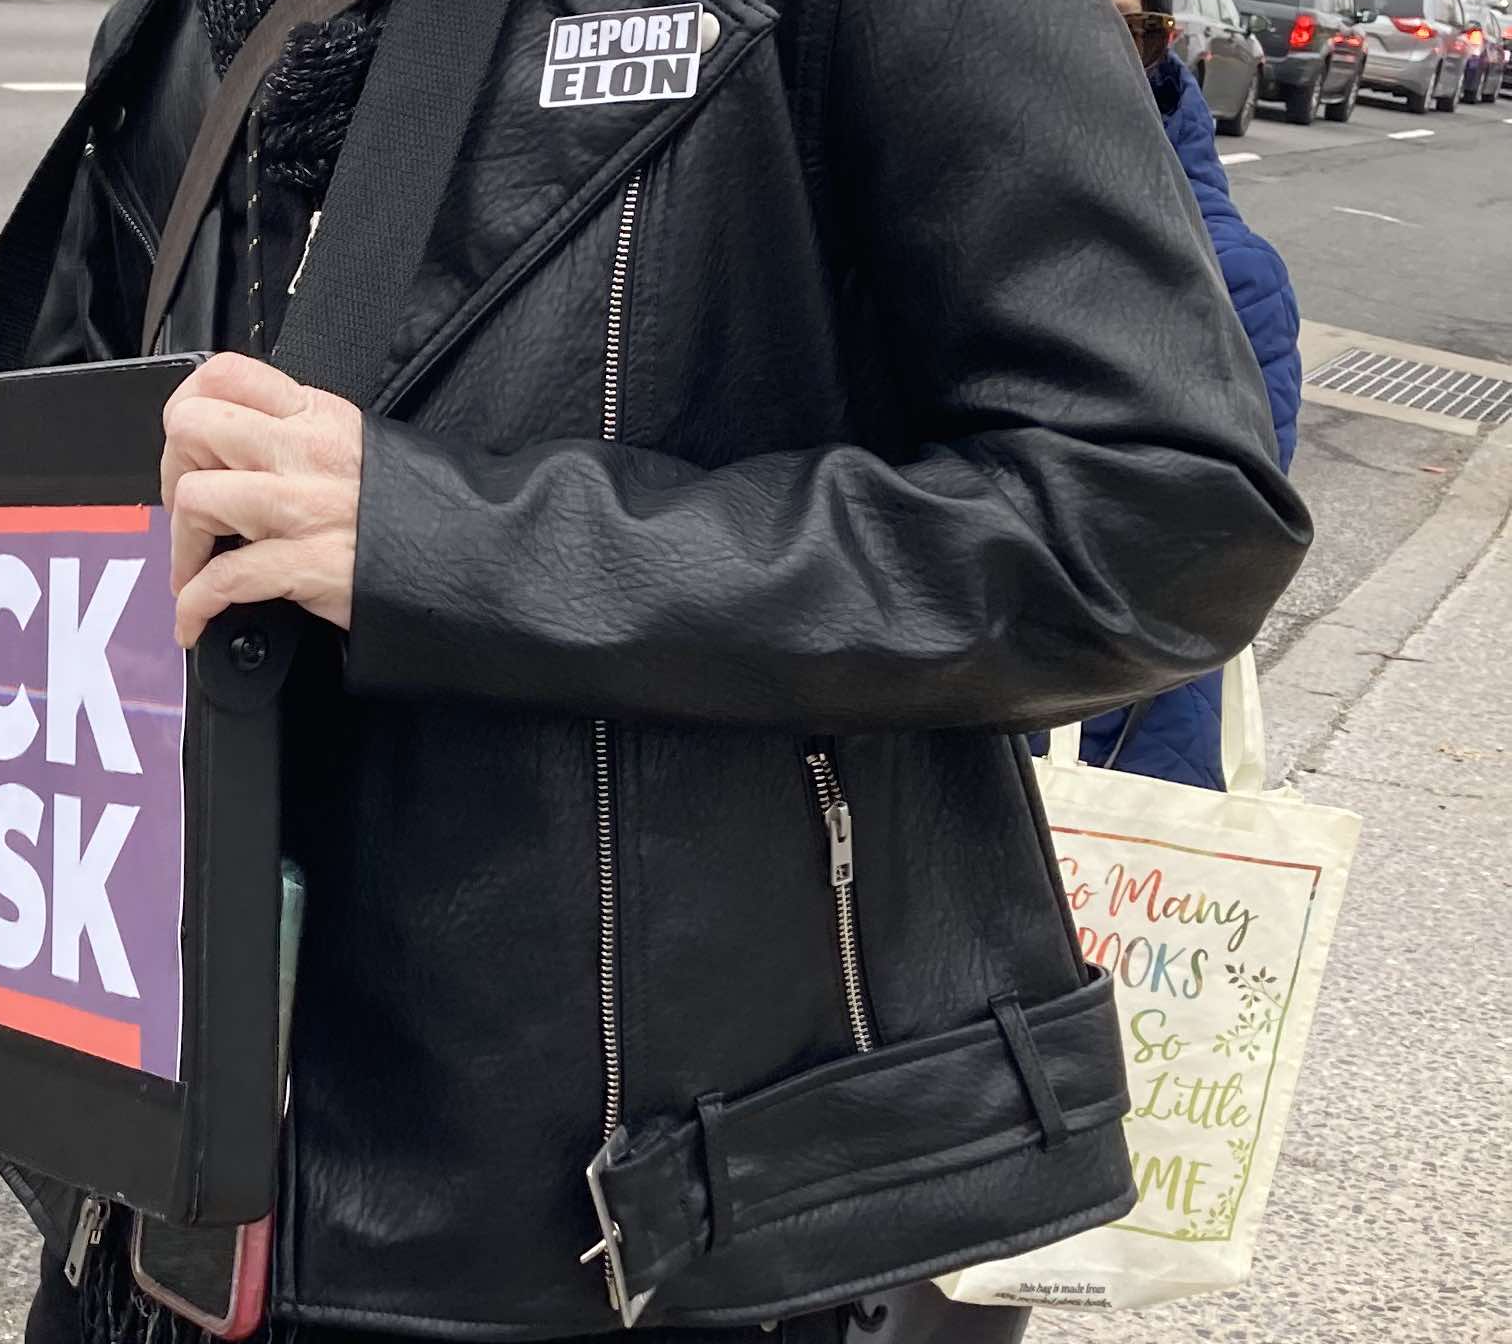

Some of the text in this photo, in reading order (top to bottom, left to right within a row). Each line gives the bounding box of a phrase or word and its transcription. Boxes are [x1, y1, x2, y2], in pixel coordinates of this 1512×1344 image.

[553, 12, 695, 61] DEPORT
[549, 57, 691, 103] ELON
[1105, 863, 1259, 952] Many
[1130, 1009, 1191, 1063] So
[1135, 1072, 1252, 1128] Little
